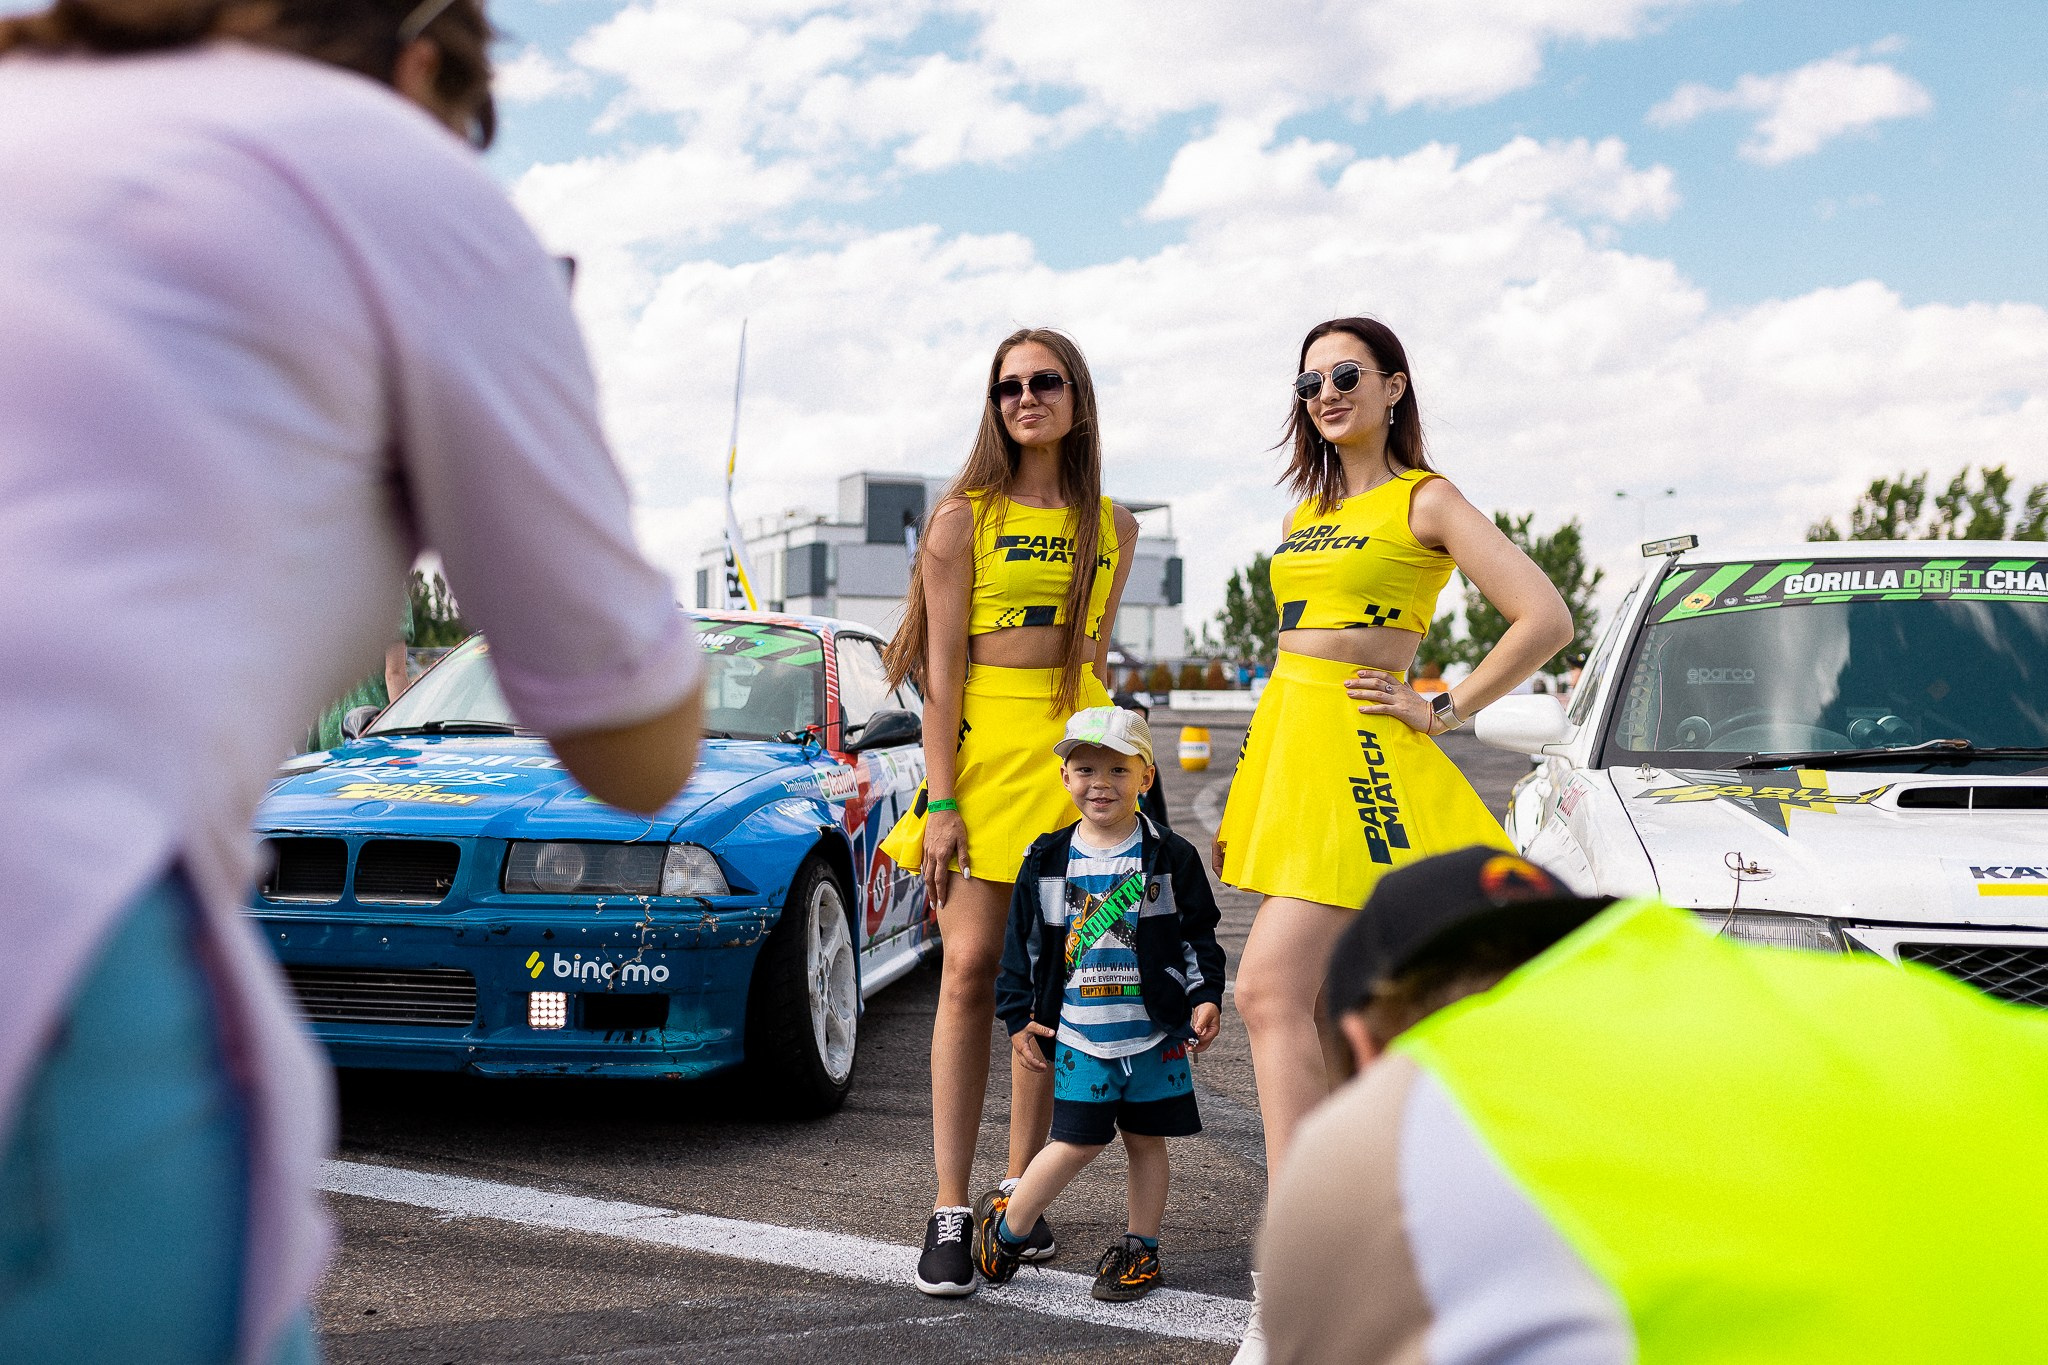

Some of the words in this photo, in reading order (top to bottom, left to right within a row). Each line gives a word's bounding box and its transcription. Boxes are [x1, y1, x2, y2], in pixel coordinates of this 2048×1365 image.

[1286, 525, 1341, 541] PARI
[994, 535, 1075, 551] PARI
[1274, 536, 1370, 555] MATCH
[1005, 548, 1111, 570] MATH
[1783, 570, 1900, 594] GORILLA
[1903, 569, 1985, 593] DRIFT
[1986, 570, 2048, 592] CHA
[338, 791, 482, 804] MATCH
[1357, 730, 1411, 849] MATCH
[1349, 777, 1393, 865] PARI
[1091, 963, 1107, 973] YOU
[1110, 962, 1136, 972] WANT
[1098, 975, 1140, 983] EVERYTHING
[1082, 986, 1102, 996] EMPTY
